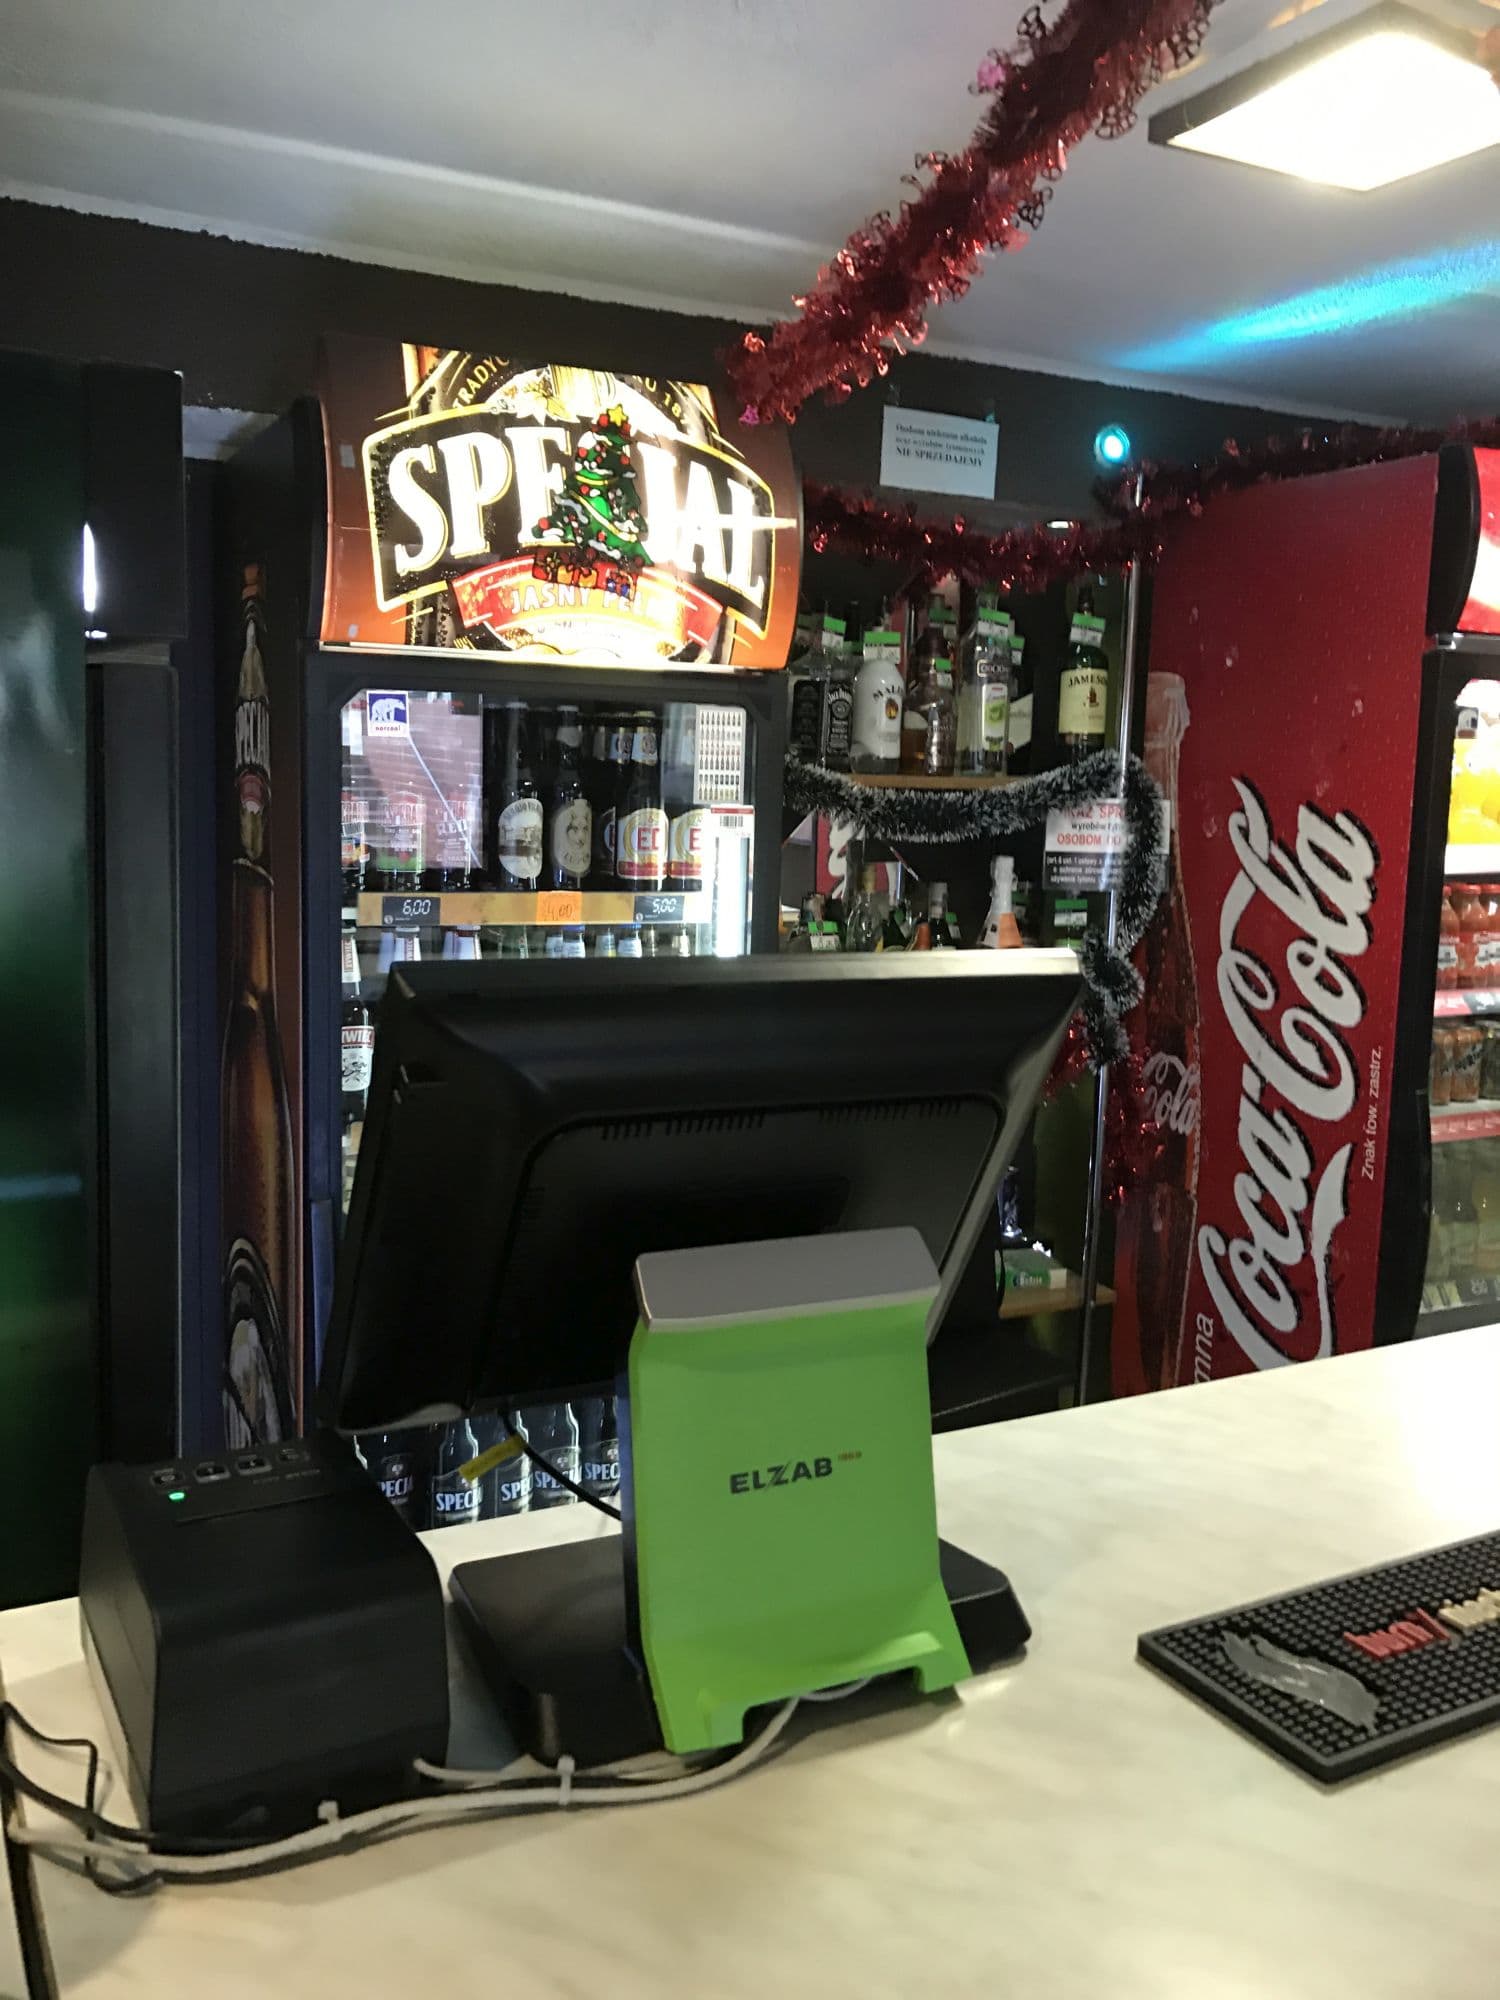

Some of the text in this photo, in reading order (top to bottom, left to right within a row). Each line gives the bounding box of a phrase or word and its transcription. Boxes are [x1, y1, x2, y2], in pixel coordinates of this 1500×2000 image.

[896, 446, 983, 467] NIE SPRZEDAJEMY
[511, 585, 592, 614] JASNY
[1057, 833, 1102, 846] OSOBOM
[402, 899, 431, 916] 6,00
[653, 898, 677, 915] 5,00
[1199, 777, 1377, 1371] Coca-Cola
[1361, 1045, 1384, 1181] Znak tow. zastrz.
[729, 1456, 833, 1495] ELZAB
